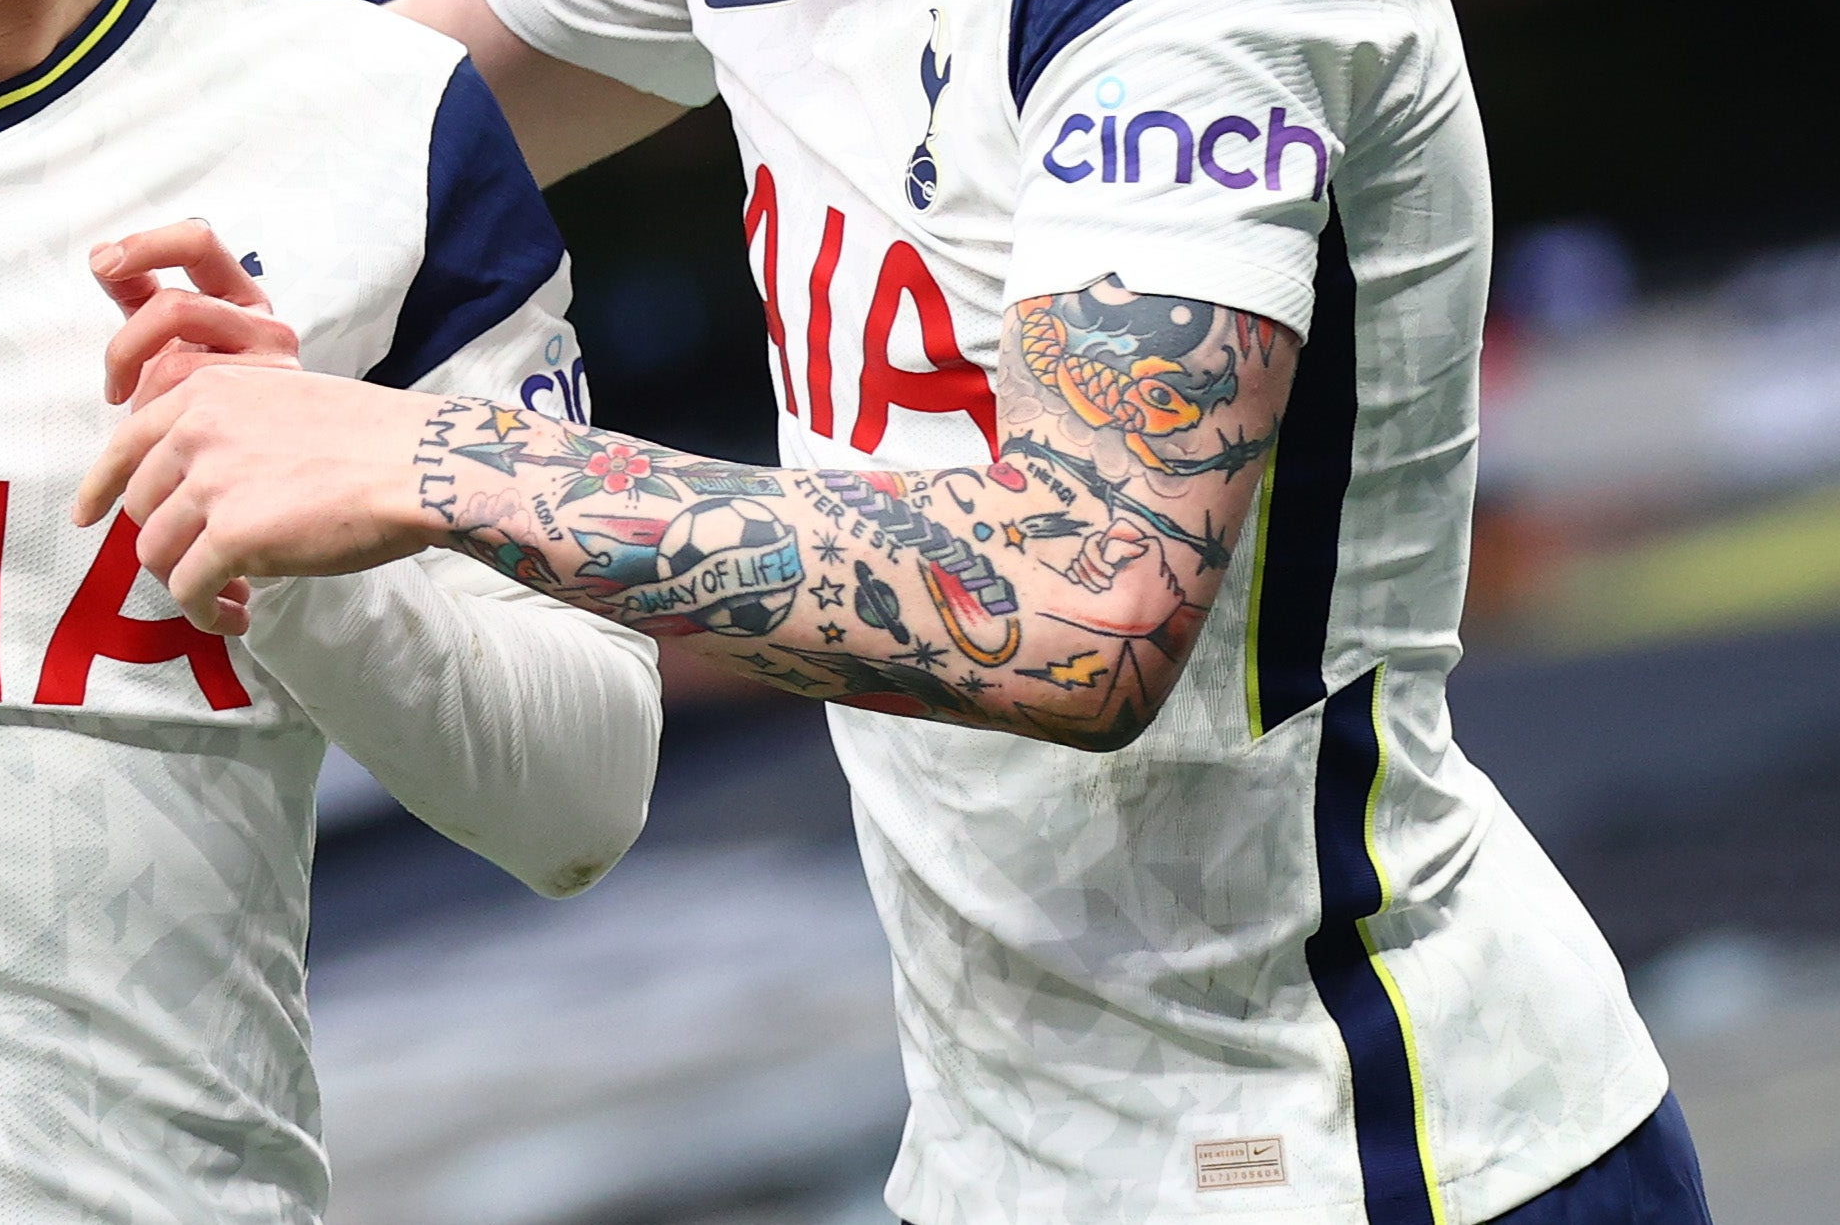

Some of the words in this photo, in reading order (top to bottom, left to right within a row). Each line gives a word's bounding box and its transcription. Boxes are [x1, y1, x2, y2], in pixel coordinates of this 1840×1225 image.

[1042, 75, 1328, 203] cinch
[744, 163, 999, 465] AIA
[412, 395, 494, 524] FAMILY
[794, 476, 846, 530] ITER
[701, 559, 727, 594] OF
[735, 542, 797, 588] LIFE
